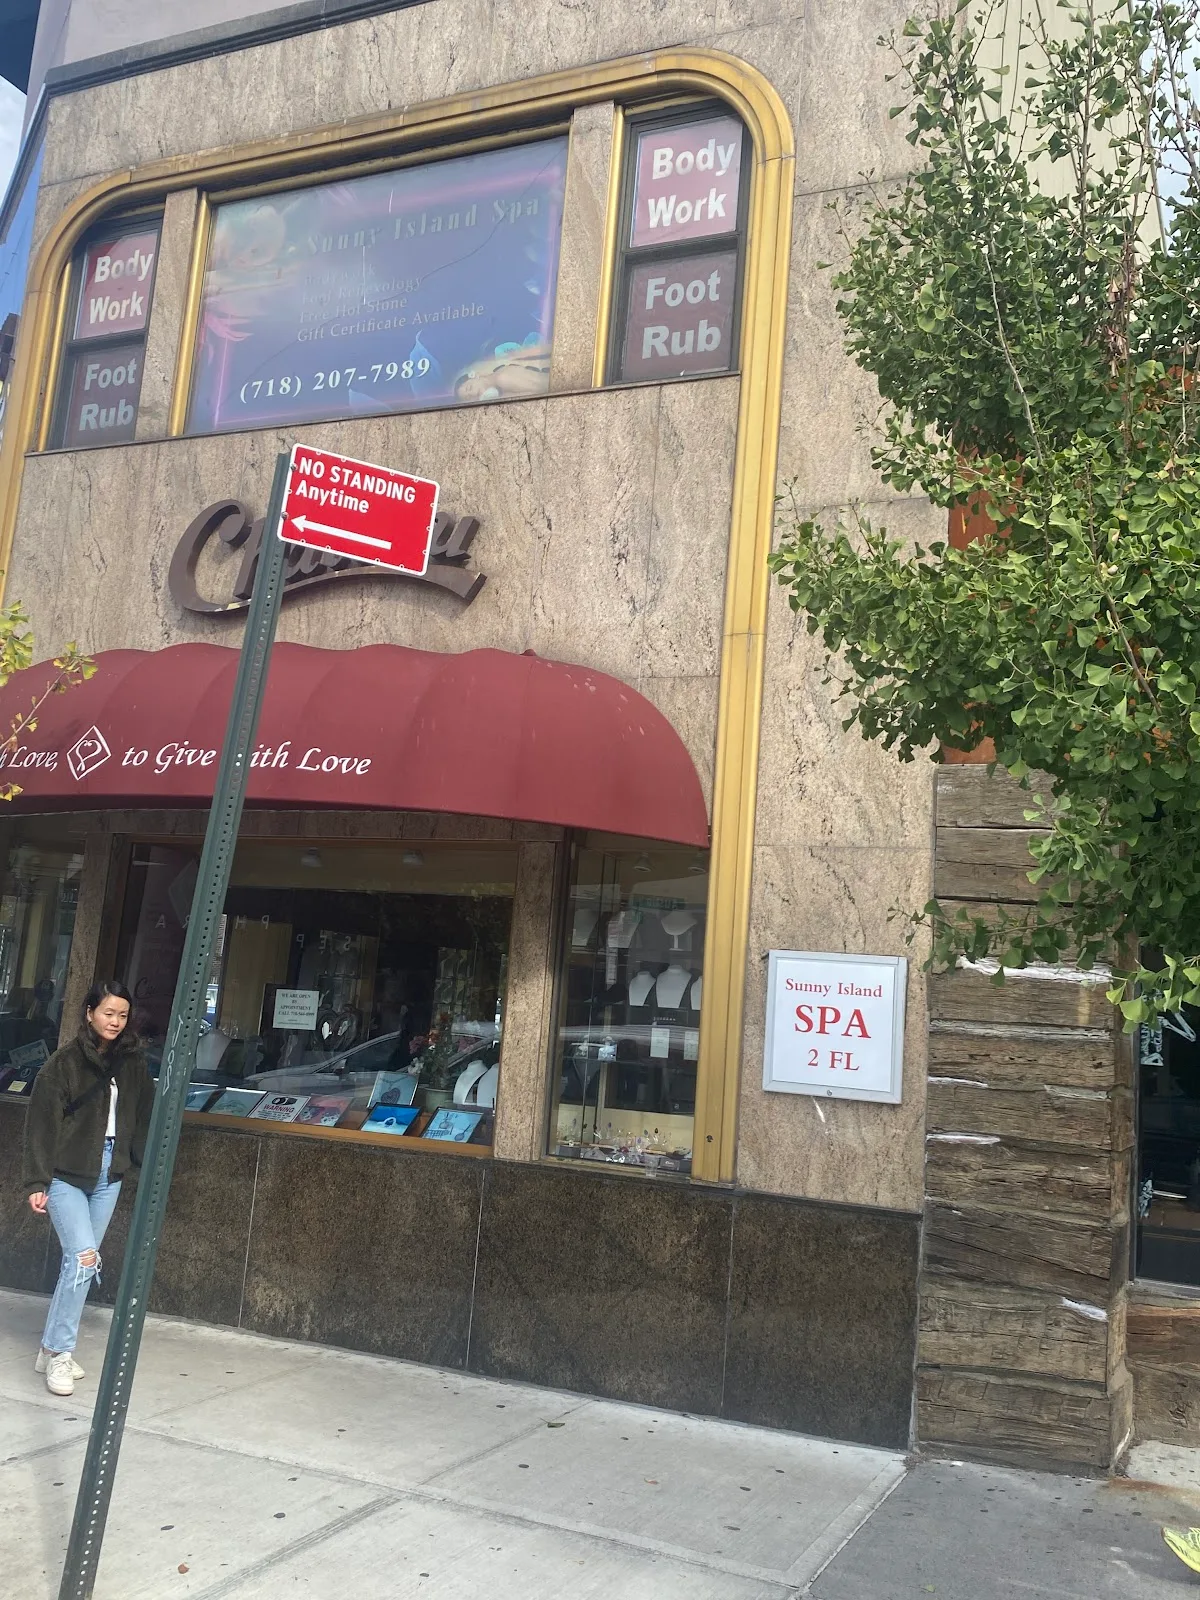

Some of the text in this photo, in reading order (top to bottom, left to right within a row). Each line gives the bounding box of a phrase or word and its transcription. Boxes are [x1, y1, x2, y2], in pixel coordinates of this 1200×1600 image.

[652, 139, 736, 180] Body
[647, 187, 727, 229] Work
[306, 197, 540, 255] Sunny Island Spa
[94, 249, 154, 283] Body
[645, 269, 721, 310] Foot
[89, 291, 145, 324] Work
[297, 302, 485, 342] Gift Certificate Available
[299, 297, 408, 324] Free Hot Stone
[641, 319, 722, 360] Rub
[84, 358, 138, 391] Foot
[239, 357, 432, 404] (718) 207-7989
[78, 399, 134, 431] Rub
[295, 479, 370, 514] Anytime
[299, 457, 416, 504] NO STANDING
[7, 746, 59, 772] Love,
[121, 747, 150, 767] to
[154, 740, 218, 774] Give
[249, 741, 293, 769] ith
[296, 748, 372, 775] Love
[785, 978, 883, 998] Sunny Island
[794, 1004, 872, 1039] SPA
[807, 1048, 861, 1071] 2 FL
[263, 1104, 295, 1114] WARNING
